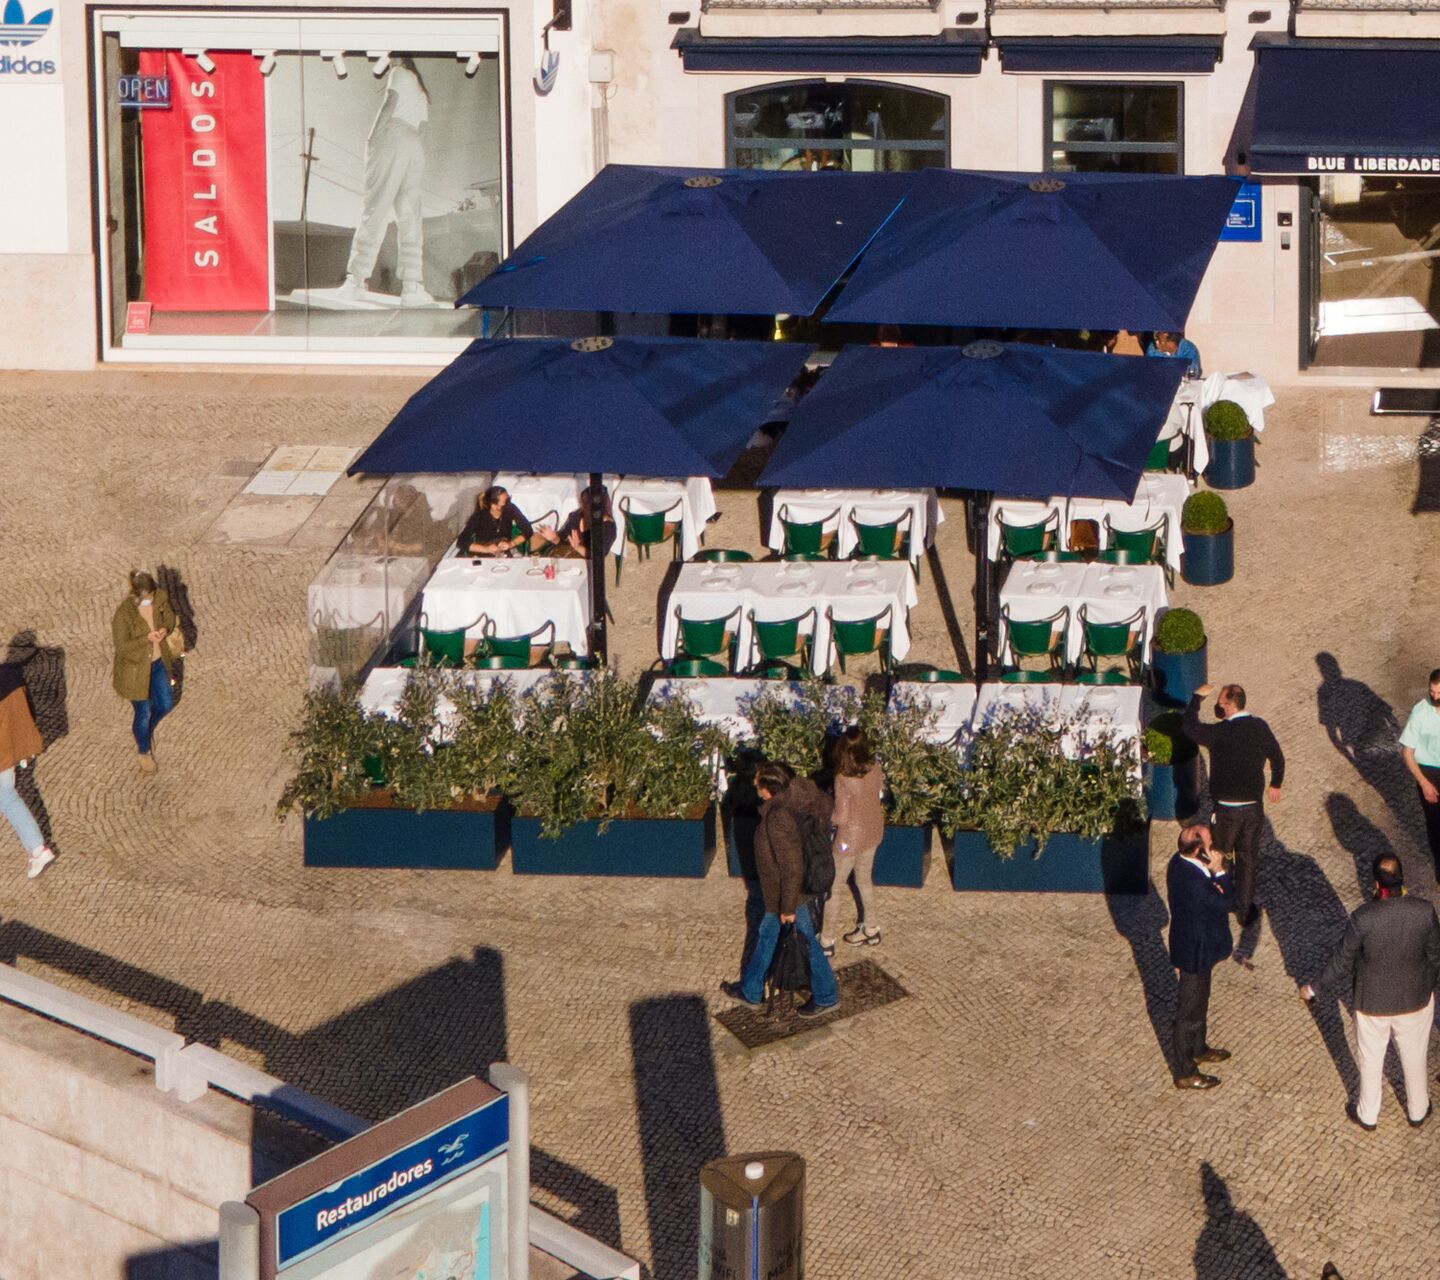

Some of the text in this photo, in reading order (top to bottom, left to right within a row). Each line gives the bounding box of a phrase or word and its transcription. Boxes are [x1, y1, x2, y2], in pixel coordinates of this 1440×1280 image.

[0, 55, 57, 75] idas
[117, 78, 169, 99] OPEN
[190, 80, 219, 268] SALDOS
[1307, 157, 1346, 170] BLUE
[1354, 158, 1440, 171] LIBERDADE
[316, 1157, 433, 1232] Restauradores
